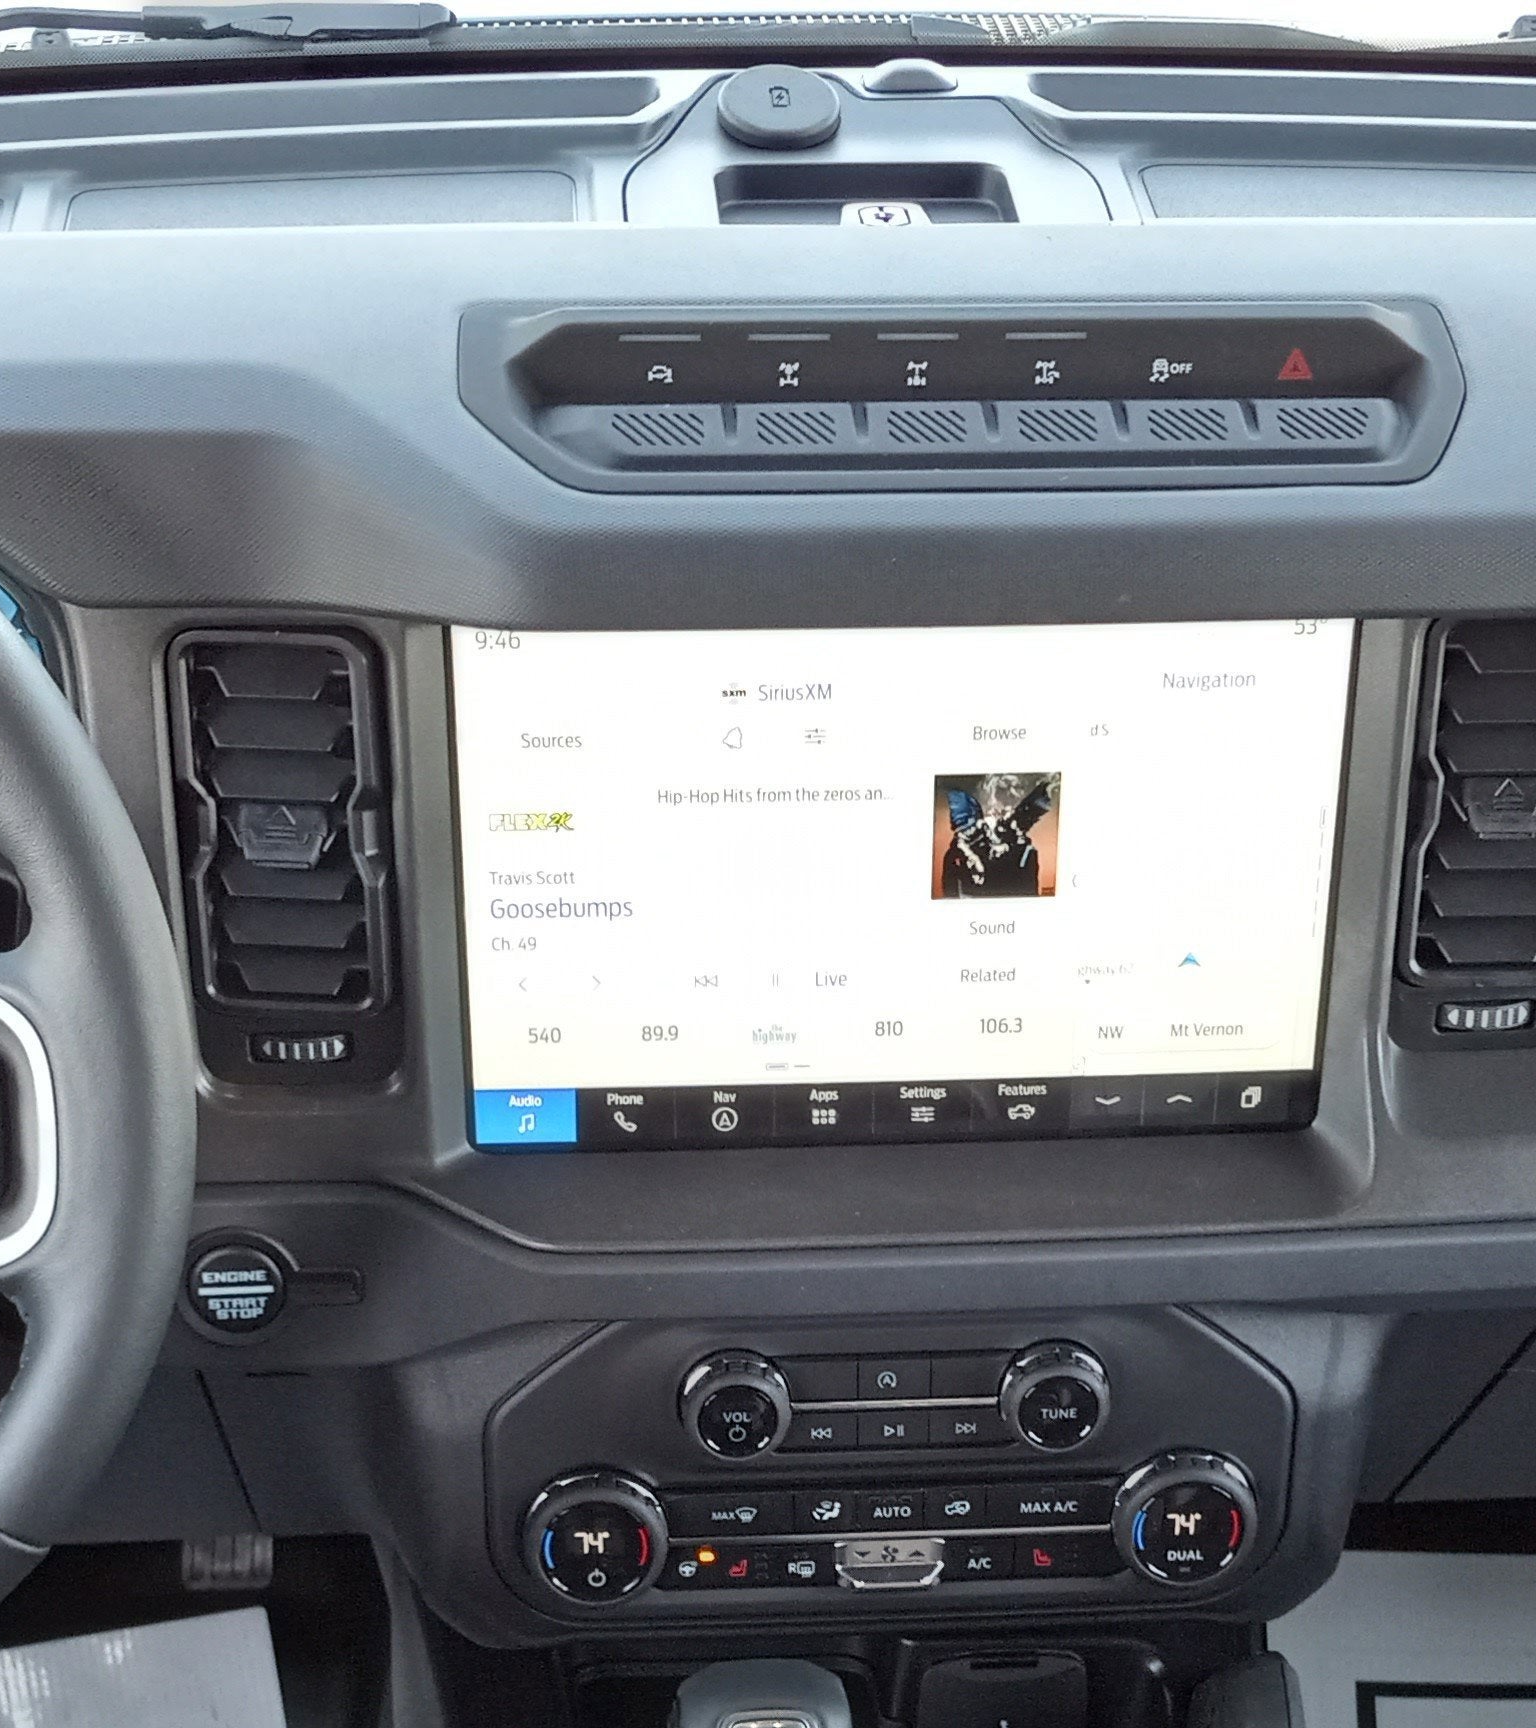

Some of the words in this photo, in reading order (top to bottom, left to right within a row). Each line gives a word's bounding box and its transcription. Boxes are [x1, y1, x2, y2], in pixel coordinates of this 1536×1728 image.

[1170, 363, 1193, 374] OFF
[474, 630, 521, 650] 9:46
[1162, 672, 1257, 692] Navigation
[722, 689, 747, 698] sxm
[758, 683, 832, 702] SiriusXM
[520, 732, 583, 749] Sources
[971, 723, 1027, 743] Browse
[657, 790, 720, 806] Hip-Hop
[723, 788, 753, 804] Hits
[756, 788, 791, 803] from
[795, 788, 820, 802] the
[823, 789, 861, 801] zeros
[489, 871, 533, 886] Travis
[536, 870, 576, 885] Scott
[490, 897, 634, 921] Goosebumps
[969, 920, 1016, 935] Sound
[518, 936, 538, 951] 49
[815, 971, 848, 988] Live
[960, 968, 1016, 984] Related
[641, 1025, 680, 1042] 89.9
[874, 1020, 904, 1037] 810
[979, 1017, 1023, 1034] 106.3
[1097, 1025, 1124, 1041] NW
[1169, 1022, 1190, 1037] Mt
[1192, 1022, 1244, 1037] Vernon
[527, 1027, 562, 1044] 540
[752, 1028, 797, 1045] highway
[713, 1090, 737, 1104] Nav
[809, 1087, 839, 1103] Apps
[899, 1085, 948, 1101] Settings
[997, 1082, 1048, 1098] Features
[508, 1093, 543, 1108] Audio
[606, 1092, 645, 1107] Phone
[201, 1269, 269, 1285] ENGINE
[207, 1295, 269, 1311] START
[216, 1307, 264, 1321] STOP
[722, 1410, 753, 1424] VOL
[1040, 1406, 1079, 1421] TUNE
[872, 1505, 912, 1520] AUTO
[1019, 1500, 1050, 1515] MAX
[1052, 1498, 1080, 1515] A/C
[711, 1510, 736, 1522] MAX
[967, 1556, 993, 1571] A/C
[1166, 1550, 1205, 1562] DUAL
